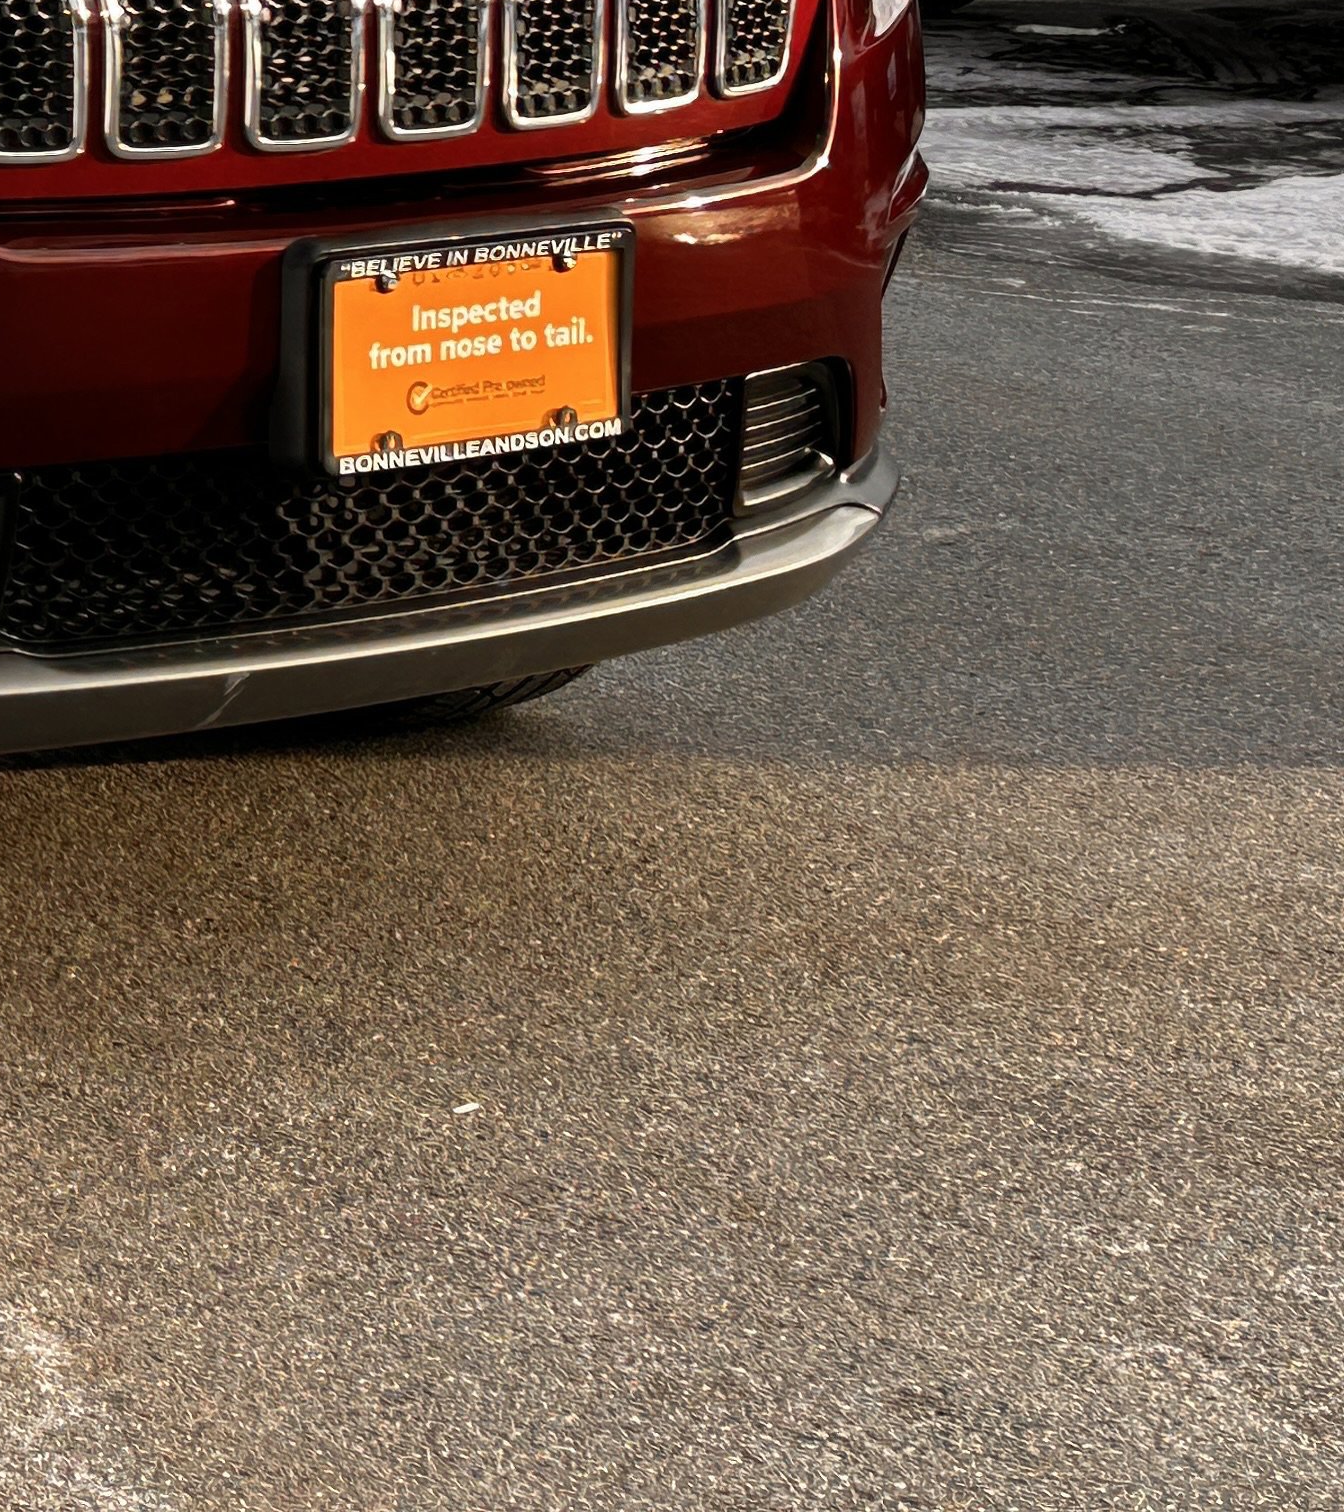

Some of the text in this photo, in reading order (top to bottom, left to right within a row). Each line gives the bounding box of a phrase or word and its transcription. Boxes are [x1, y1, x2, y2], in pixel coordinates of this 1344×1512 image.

[446, 250, 468, 267] IN
[412, 290, 542, 333] Inspected
[369, 316, 594, 370] from nose to tail.
[339, 419, 622, 476] BONNEVILLEANDSON.COM
